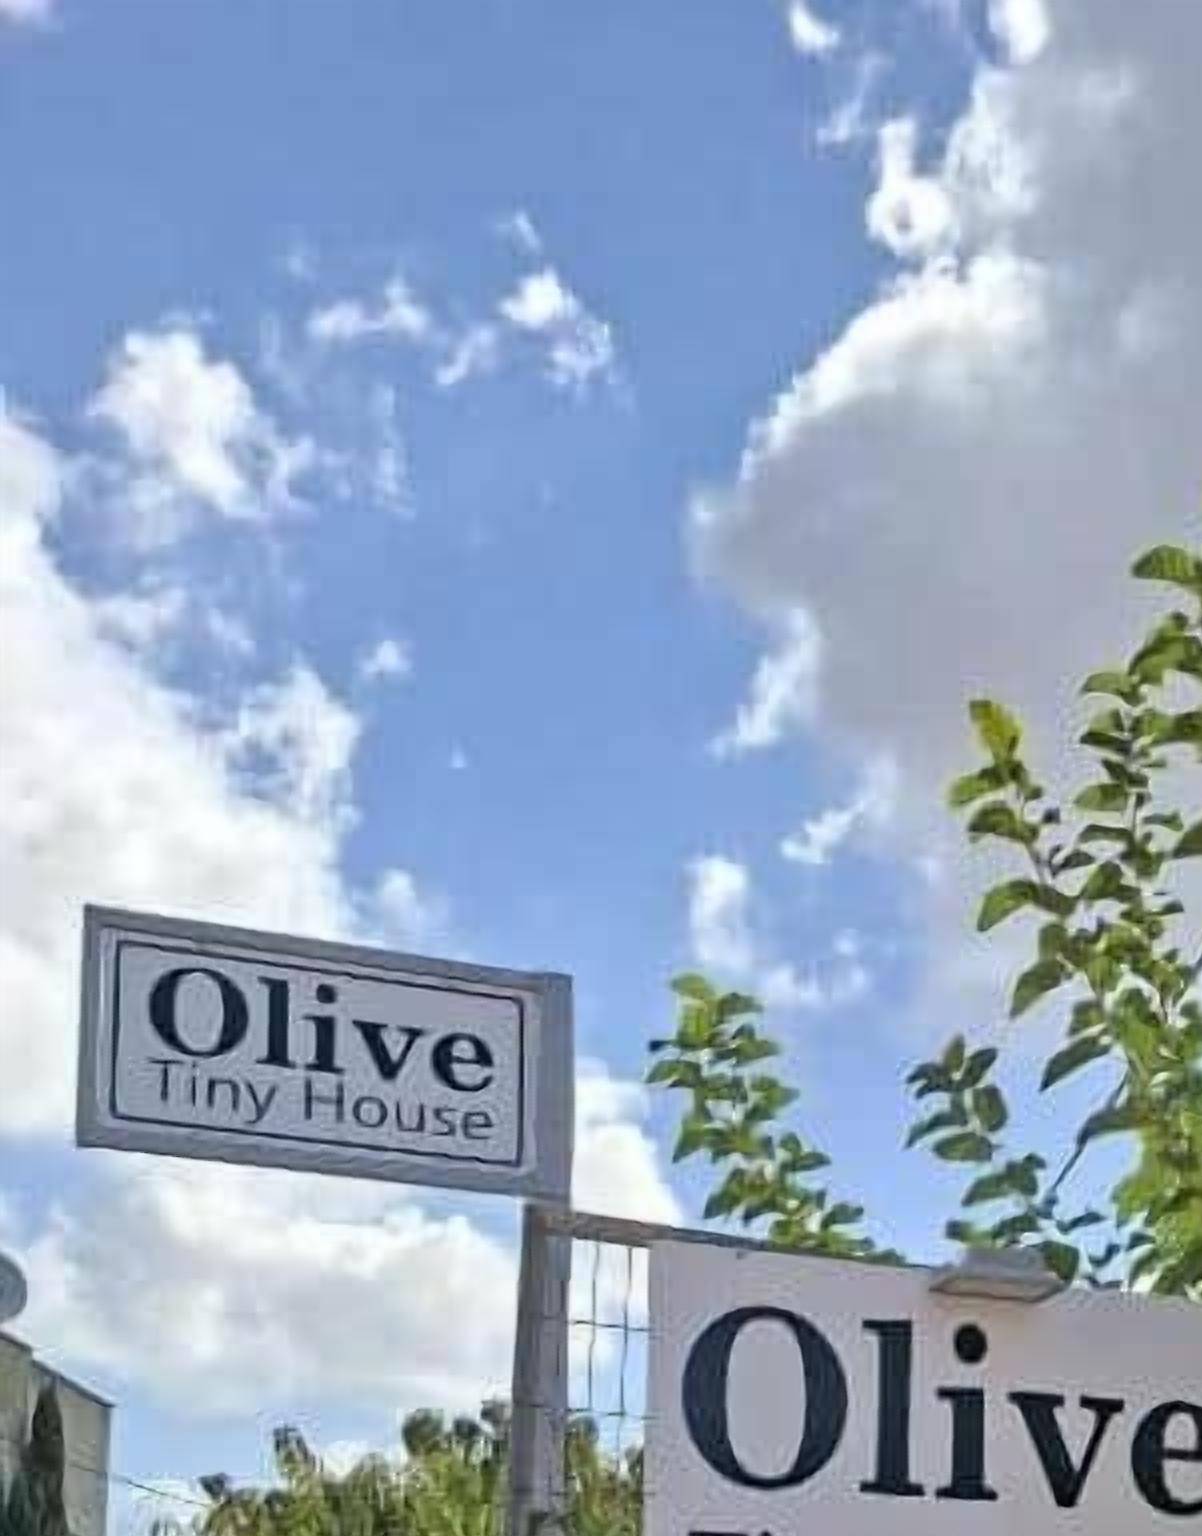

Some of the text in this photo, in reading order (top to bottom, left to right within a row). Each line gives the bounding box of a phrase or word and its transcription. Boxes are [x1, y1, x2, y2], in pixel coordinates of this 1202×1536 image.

[148, 966, 495, 1093] Olive
[148, 1058, 495, 1140] Tiny House
